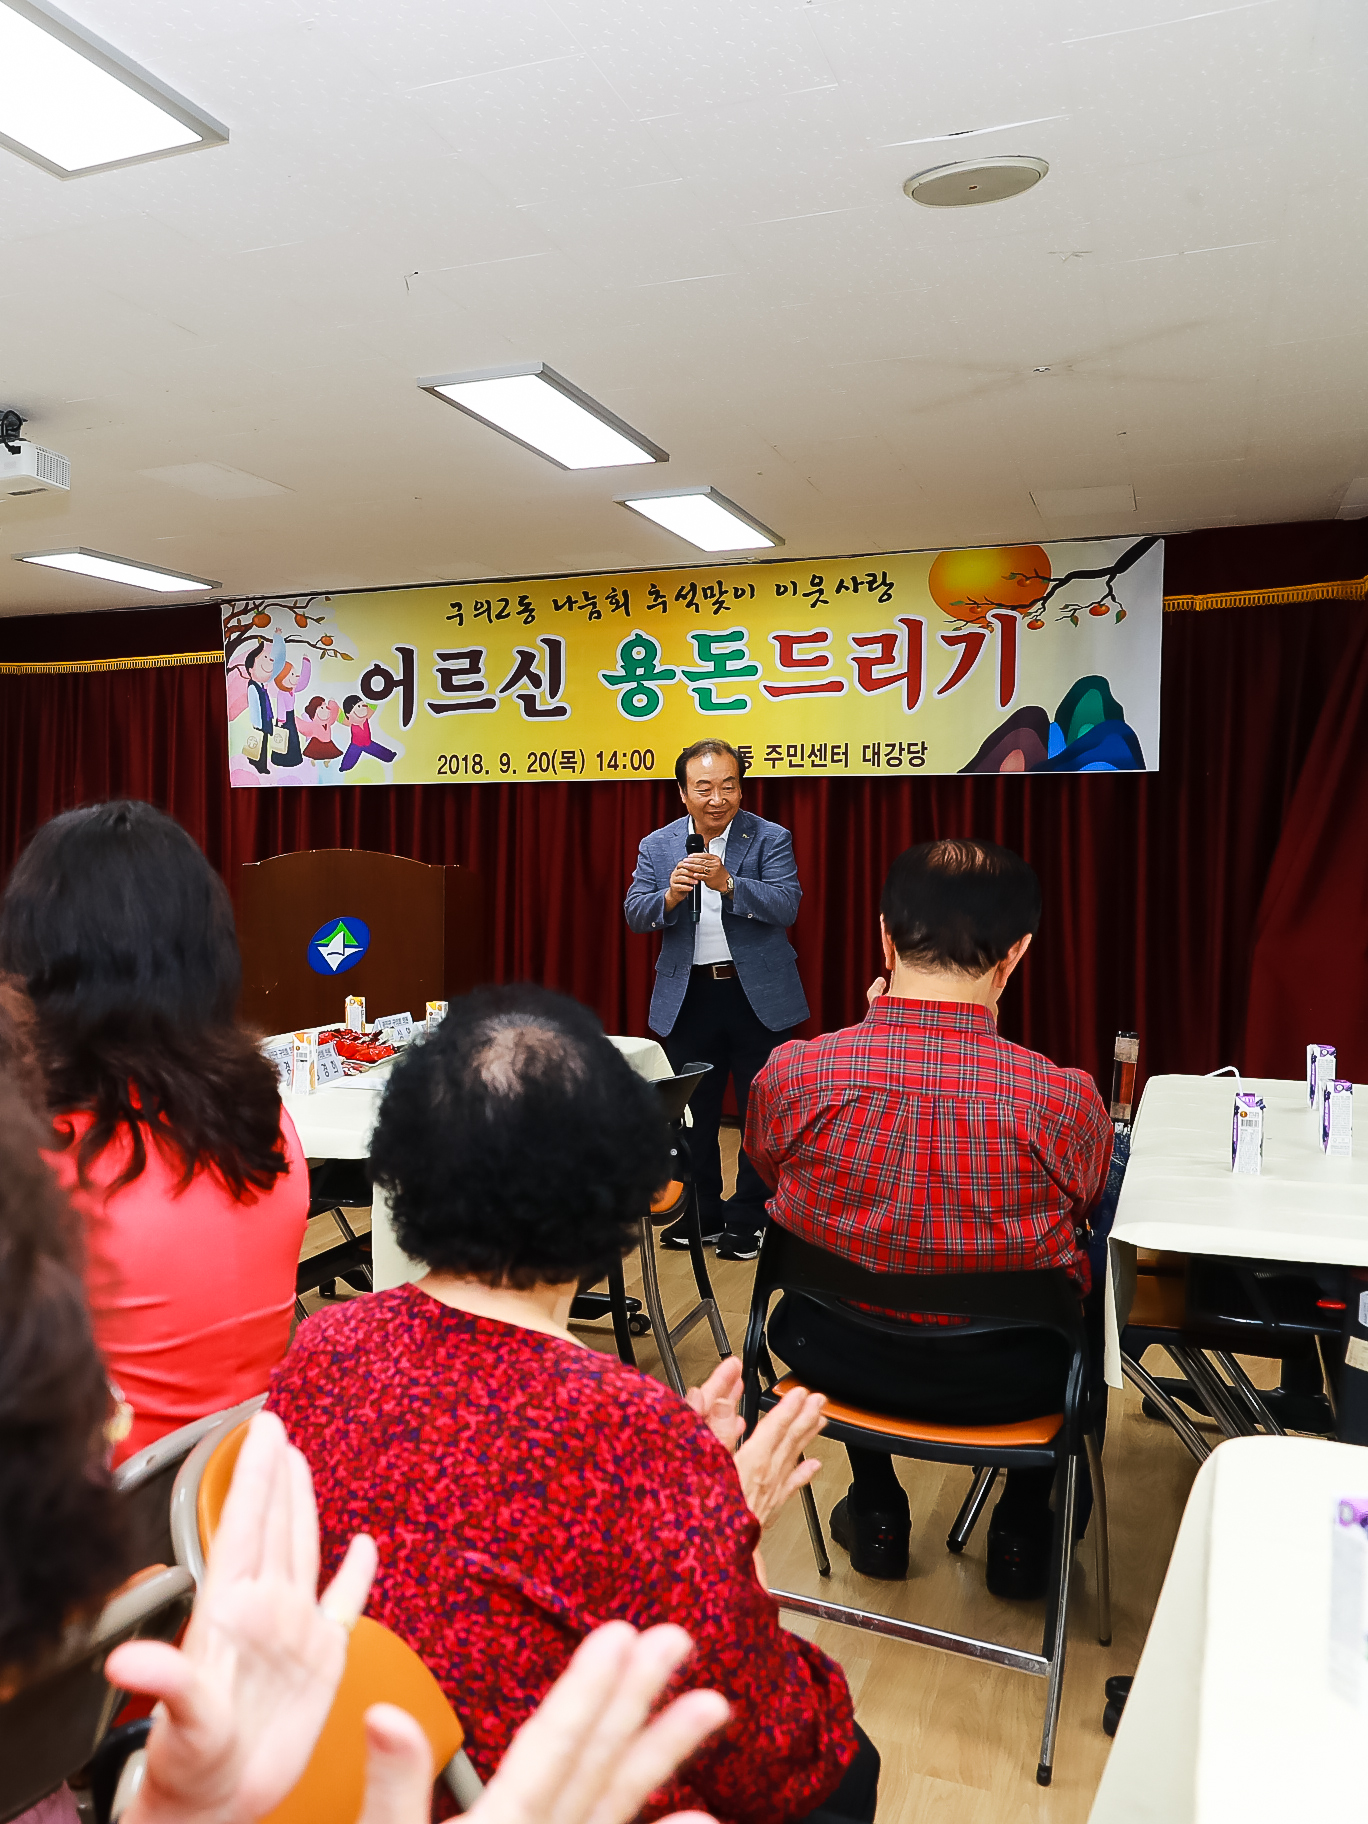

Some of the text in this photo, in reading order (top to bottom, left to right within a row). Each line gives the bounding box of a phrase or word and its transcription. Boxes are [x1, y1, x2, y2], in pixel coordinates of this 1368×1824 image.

[445, 595, 537, 626] 구의2동
[552, 587, 632, 621] 나눔회
[646, 581, 756, 616] 추석맞이
[360, 637, 567, 729] 어르신
[436, 753, 490, 776] 2018.
[498, 753, 518, 775] 9.
[526, 747, 586, 774] 20(목)
[595, 748, 656, 772] 14:00
[763, 742, 850, 770] 주민센터
[861, 741, 929, 768] 대강당
